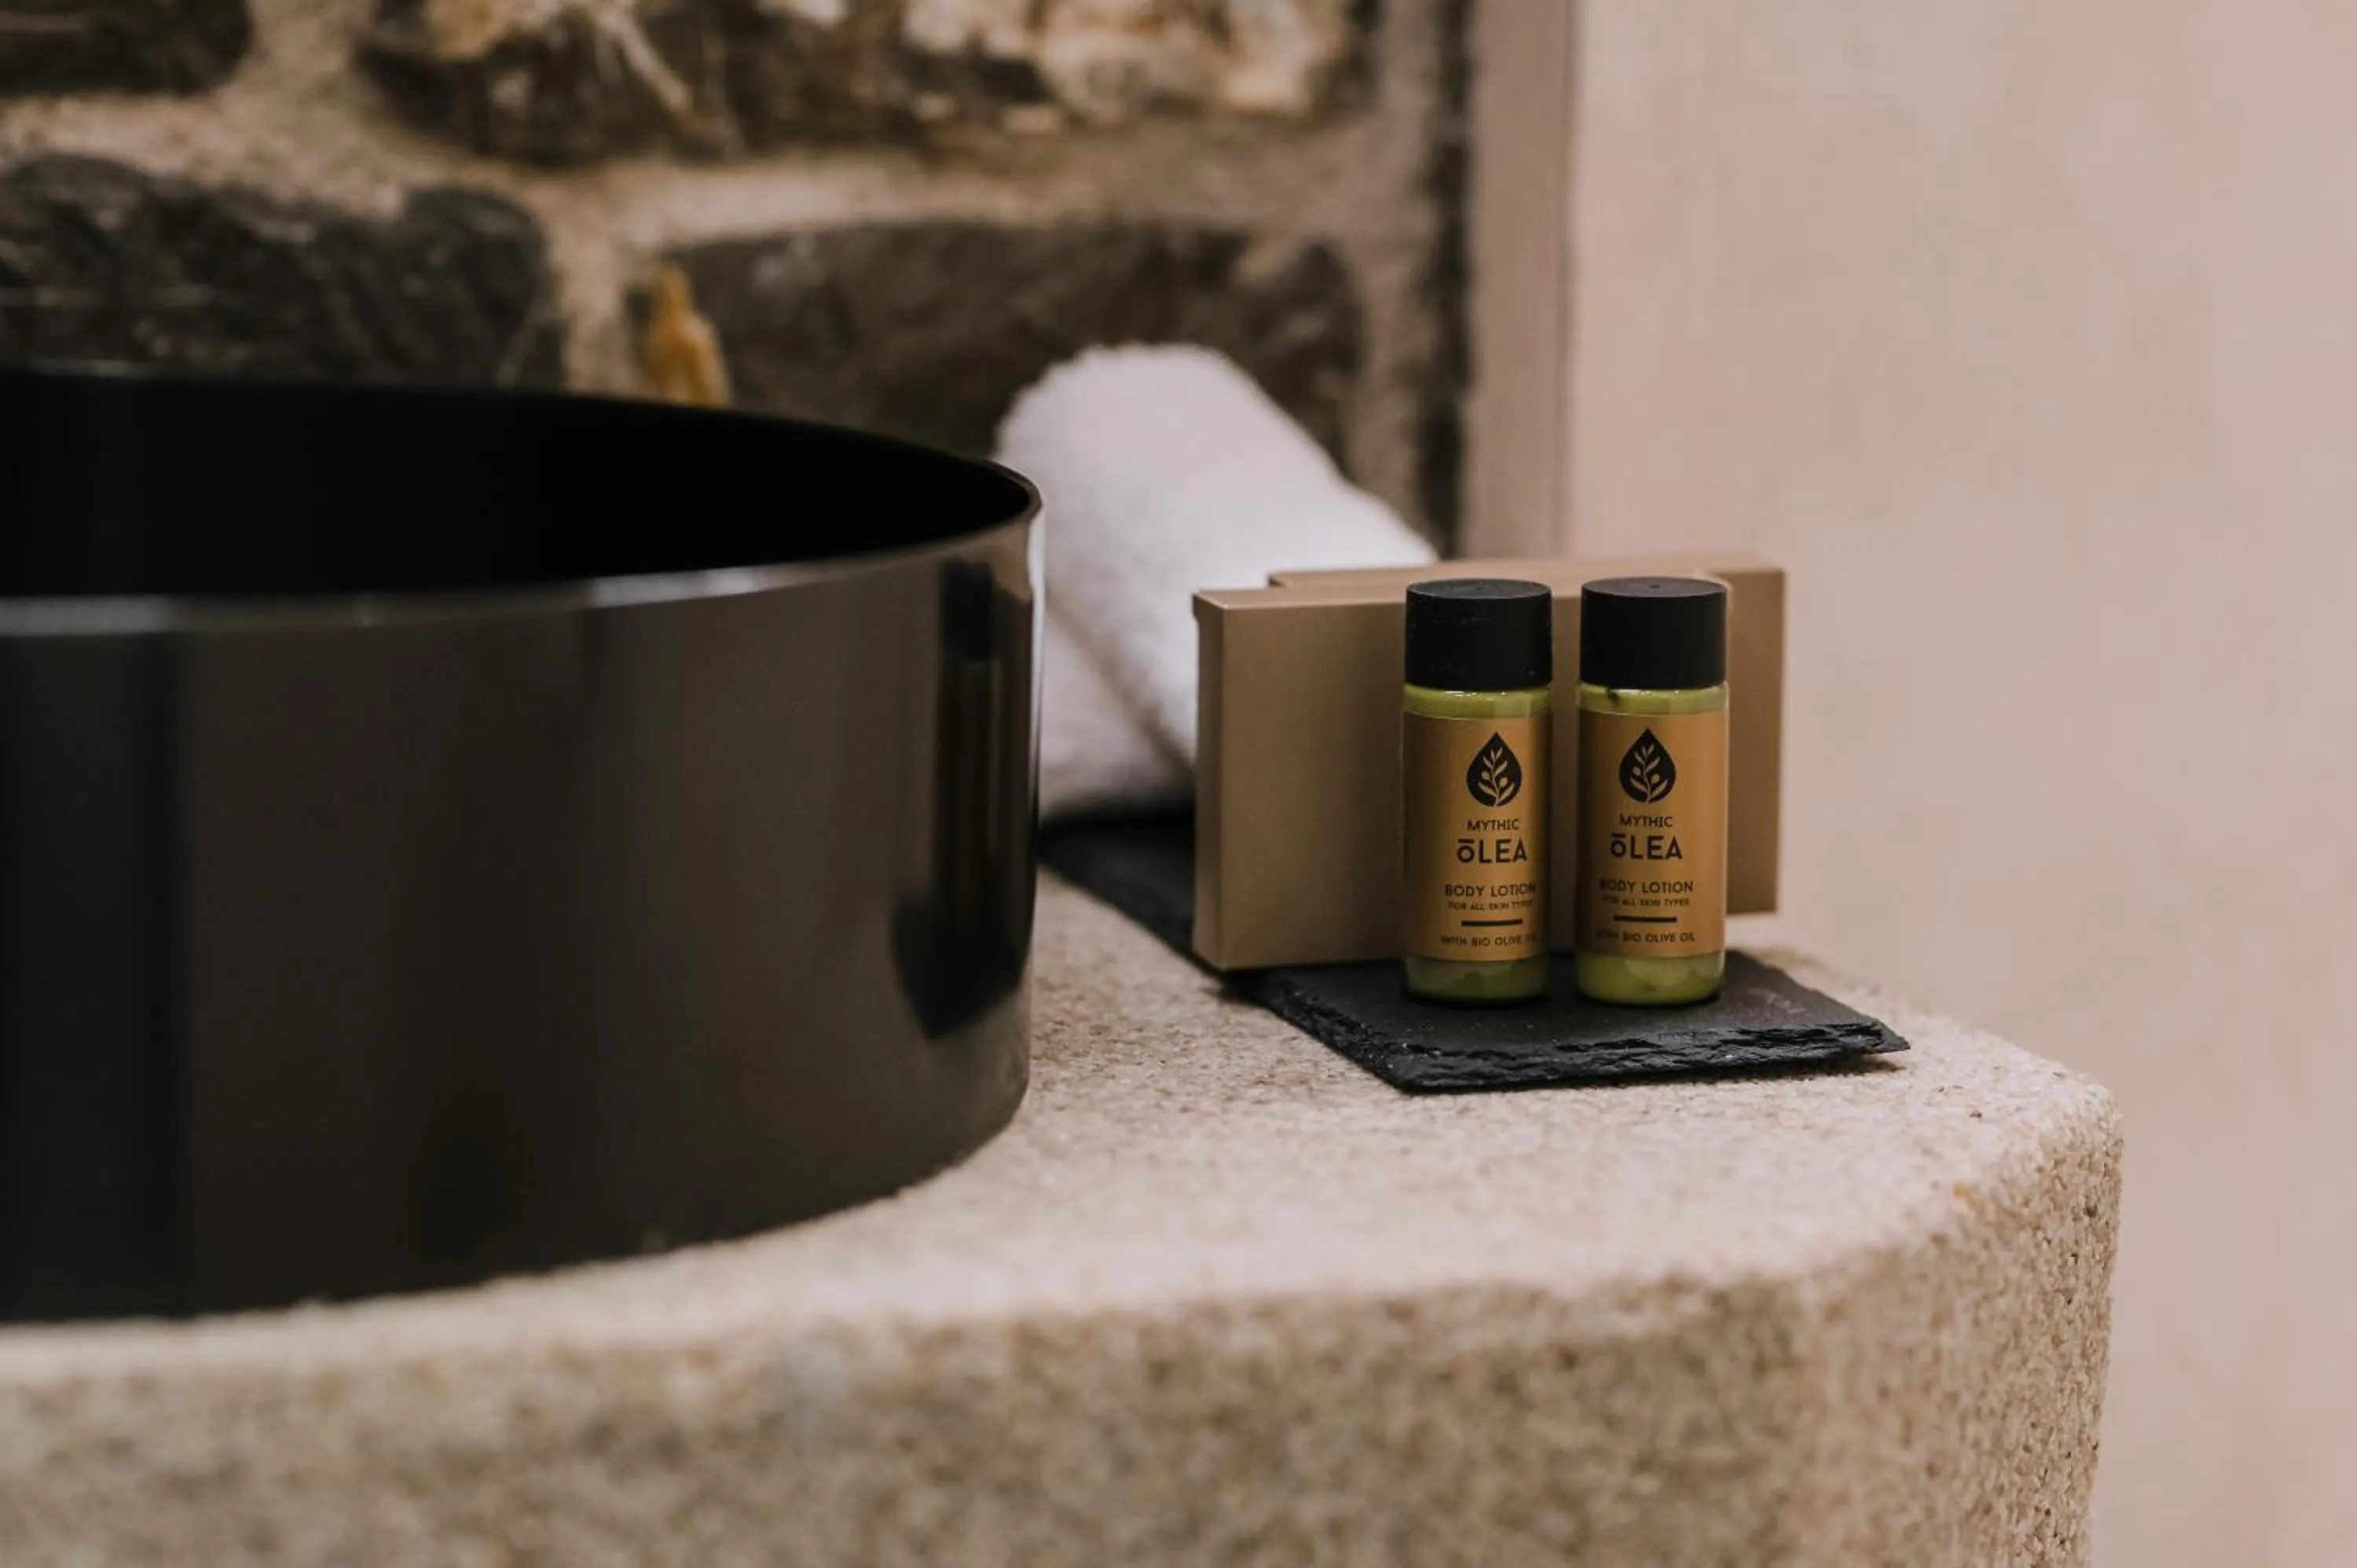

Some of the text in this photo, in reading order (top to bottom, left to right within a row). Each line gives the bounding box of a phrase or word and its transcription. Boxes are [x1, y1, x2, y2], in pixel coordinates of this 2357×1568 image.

[1467, 819, 1520, 830] MYTHIC
[1619, 814, 1673, 827] MYTHIC
[1445, 881, 1536, 896] BODY LOTION
[1600, 877, 1694, 893] BODY LOTION
[1448, 901, 1467, 910] FOR
[1470, 902, 1485, 910] ALL
[1489, 901, 1509, 910] SKIN
[1440, 935, 1467, 946] WITH
[1471, 936, 1490, 947] BIO
[1494, 935, 1522, 946] OLIVE
[1622, 931, 1641, 943] BIO
[1645, 932, 1677, 943] OLIVE
